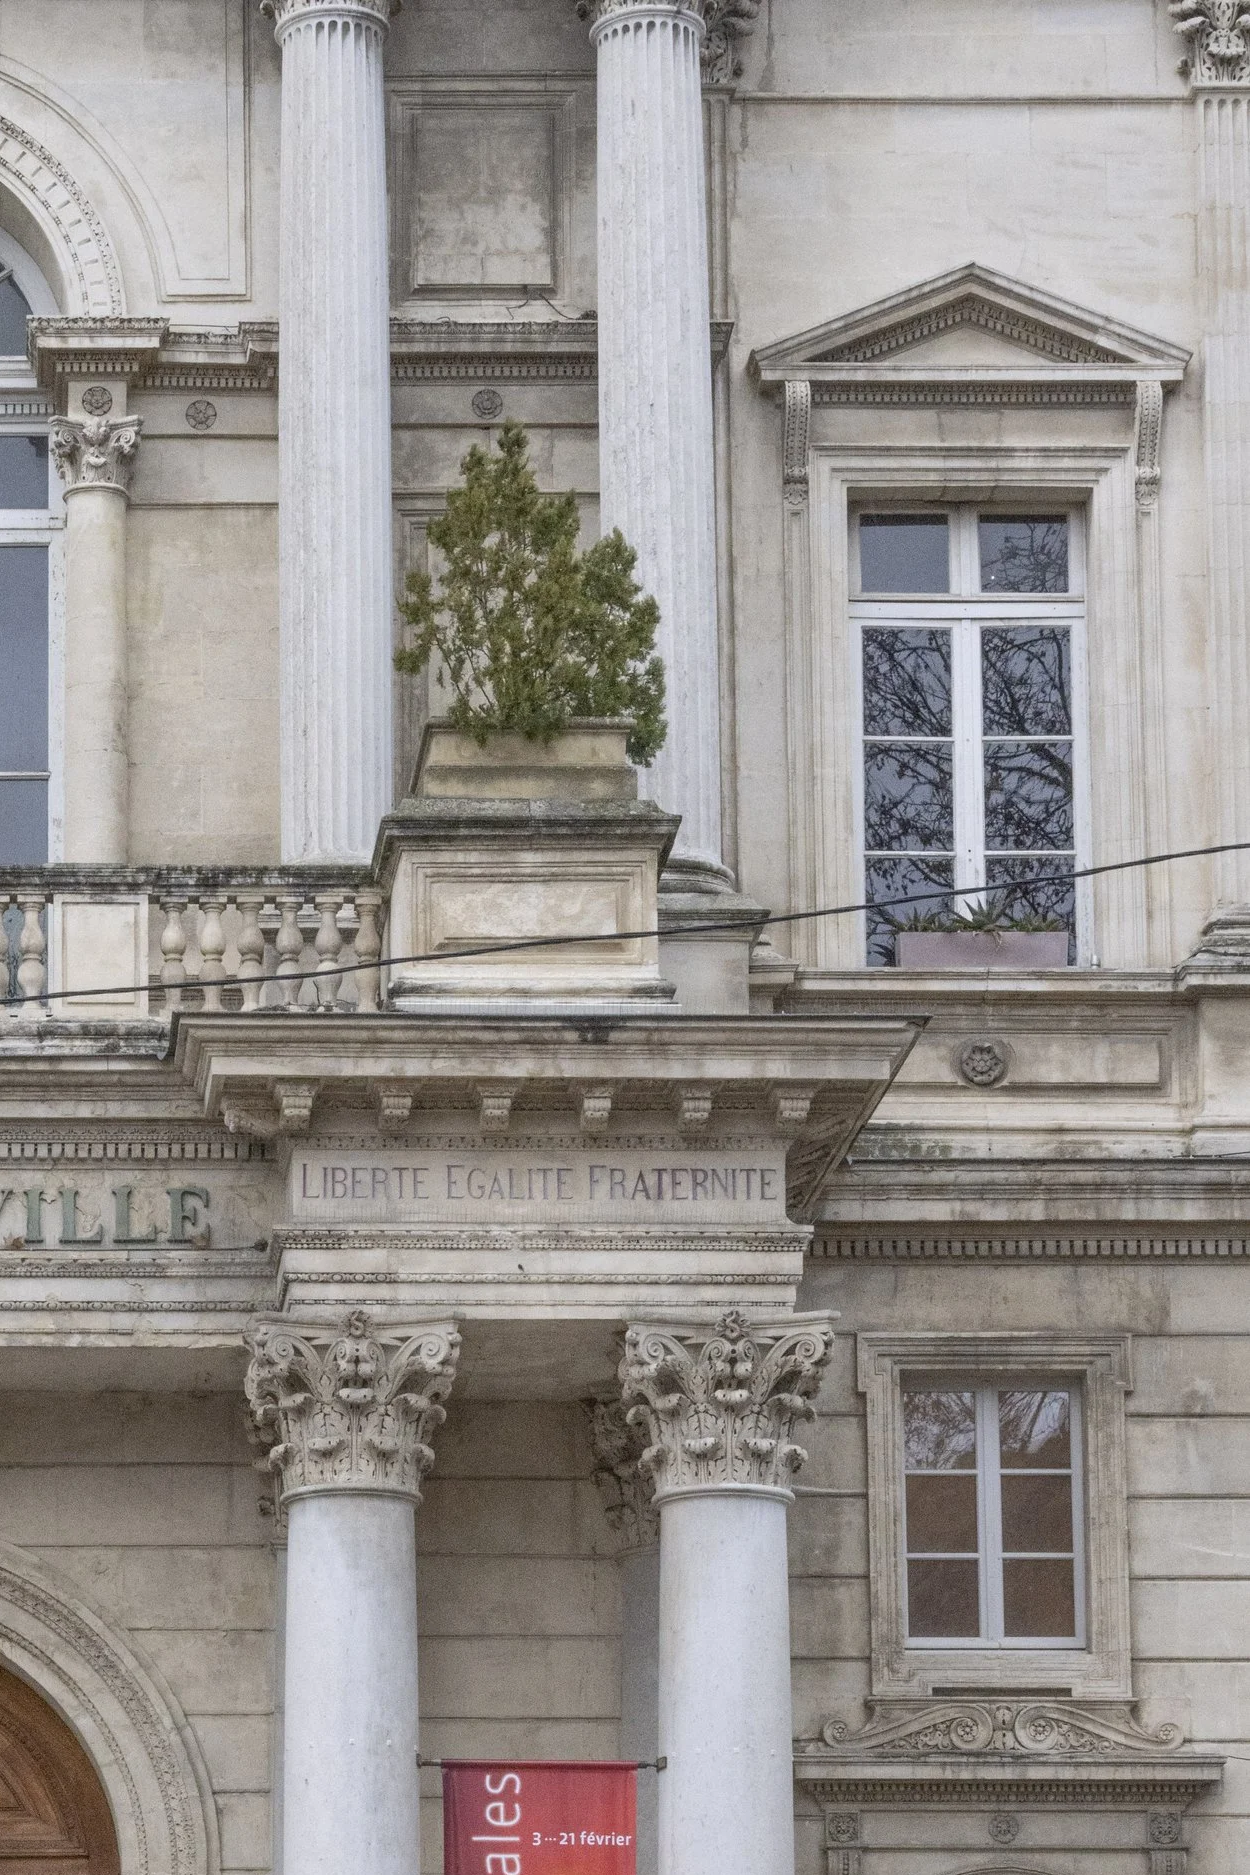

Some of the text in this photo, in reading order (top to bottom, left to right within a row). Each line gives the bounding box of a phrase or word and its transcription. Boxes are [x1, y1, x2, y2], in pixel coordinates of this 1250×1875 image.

[301, 1163, 778, 1200] LIBERTE EGALITE FRATERNITE
[532, 1832, 541, 1846] 3
[559, 1832, 576, 1845] 21
[579, 1831, 632, 1846] février
